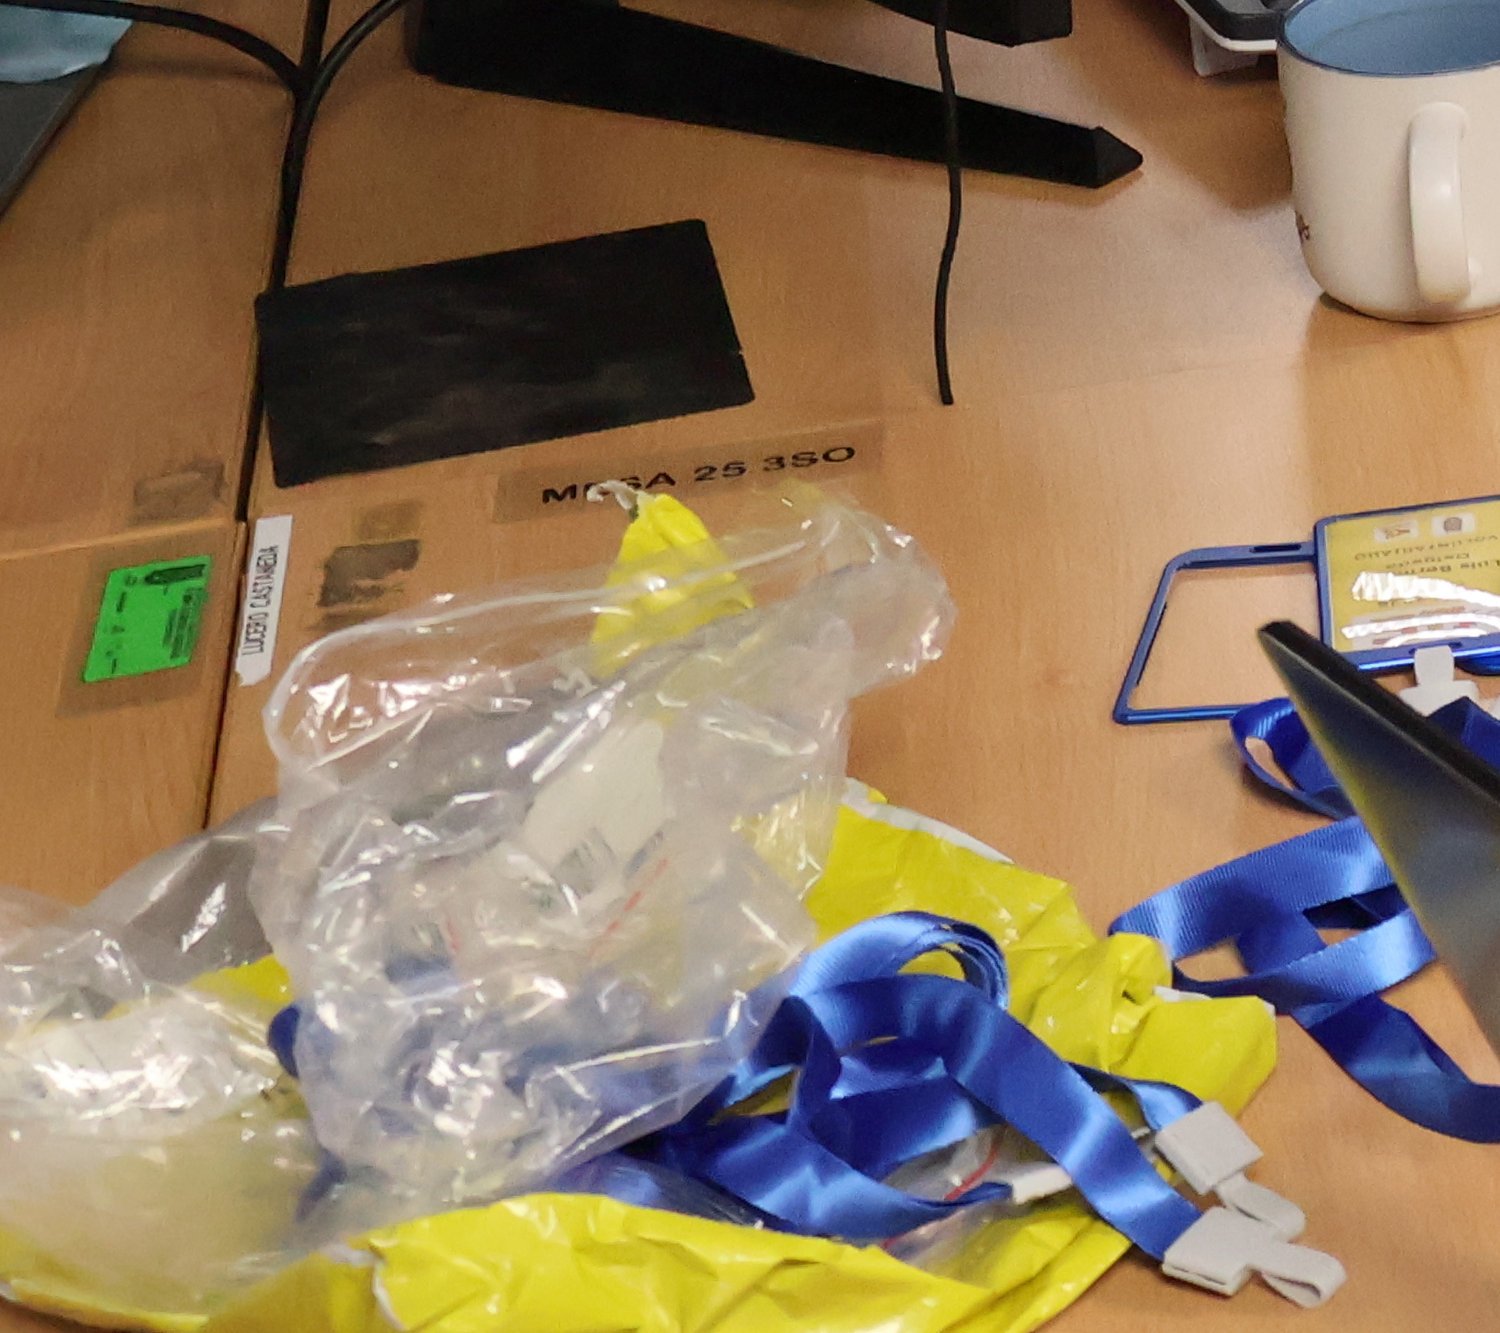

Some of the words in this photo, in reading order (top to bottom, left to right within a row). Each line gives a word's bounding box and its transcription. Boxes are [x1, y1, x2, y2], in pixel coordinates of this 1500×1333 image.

[542, 471, 676, 504] MSA
[694, 461, 748, 483] 25
[1460, 559, 1500, 570] Luis
[241, 612, 269, 656] LUCERO
